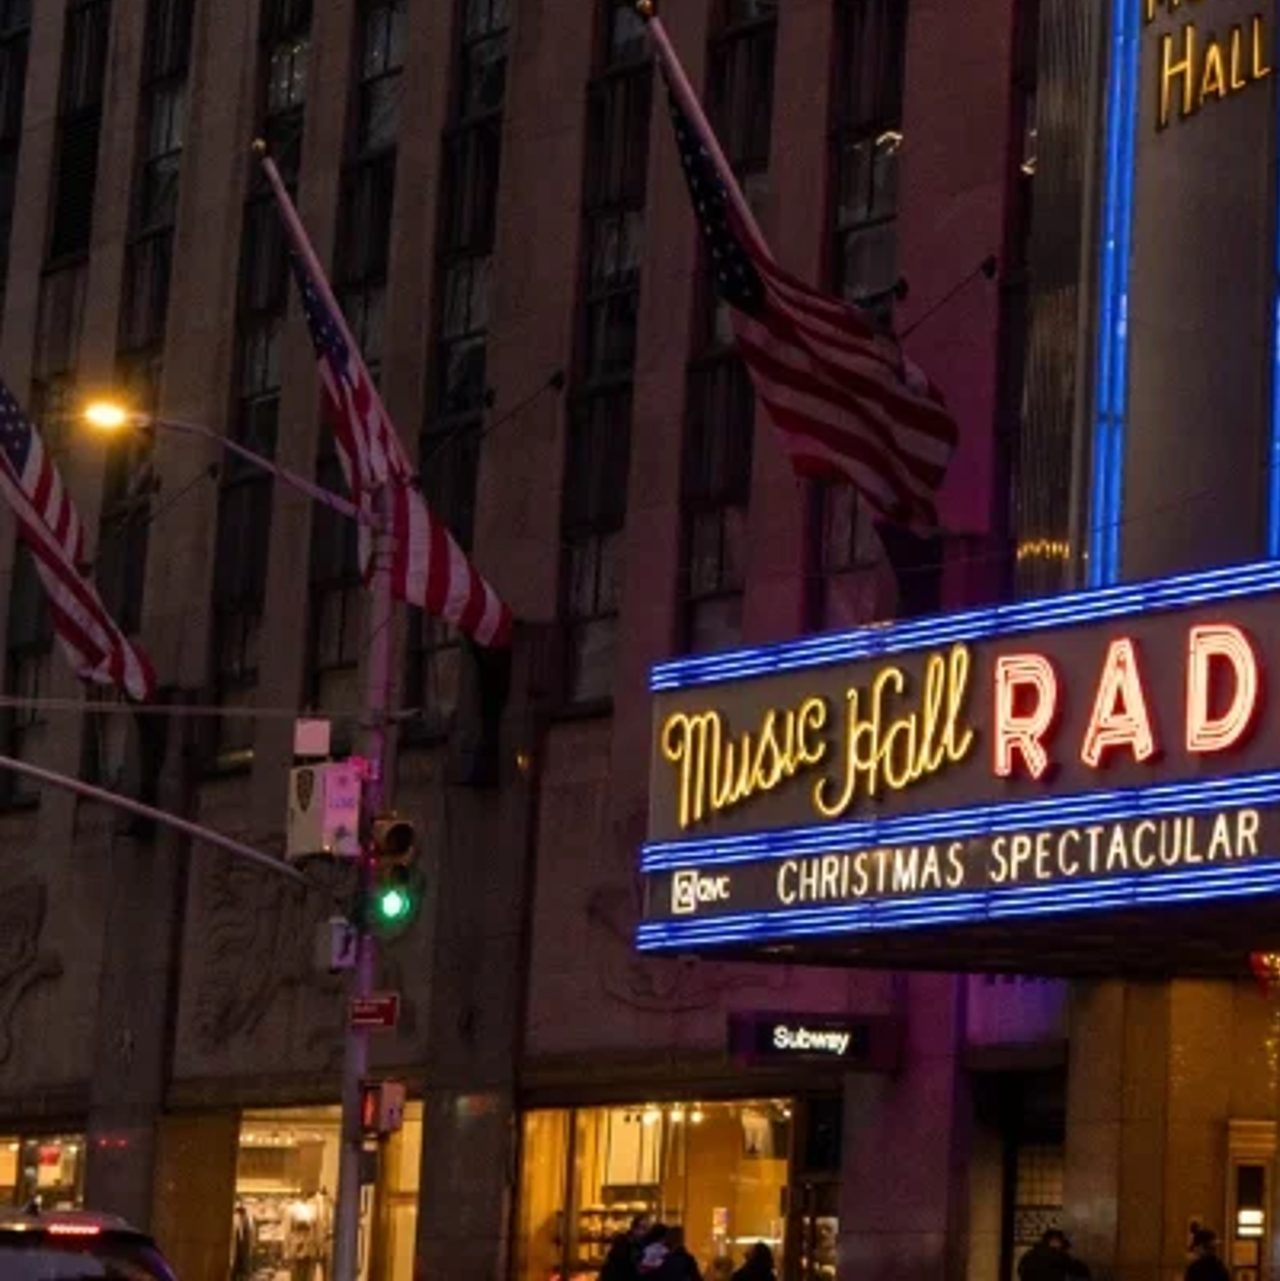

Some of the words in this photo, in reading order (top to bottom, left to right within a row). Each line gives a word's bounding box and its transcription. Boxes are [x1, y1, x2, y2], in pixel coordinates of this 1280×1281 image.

[662, 697, 825, 828] Music
[813, 642, 973, 818] Hall
[777, 843, 963, 904] CHRISTMAS
[990, 809, 1259, 883] SPECTACULAR
[773, 1024, 851, 1056] Subway
